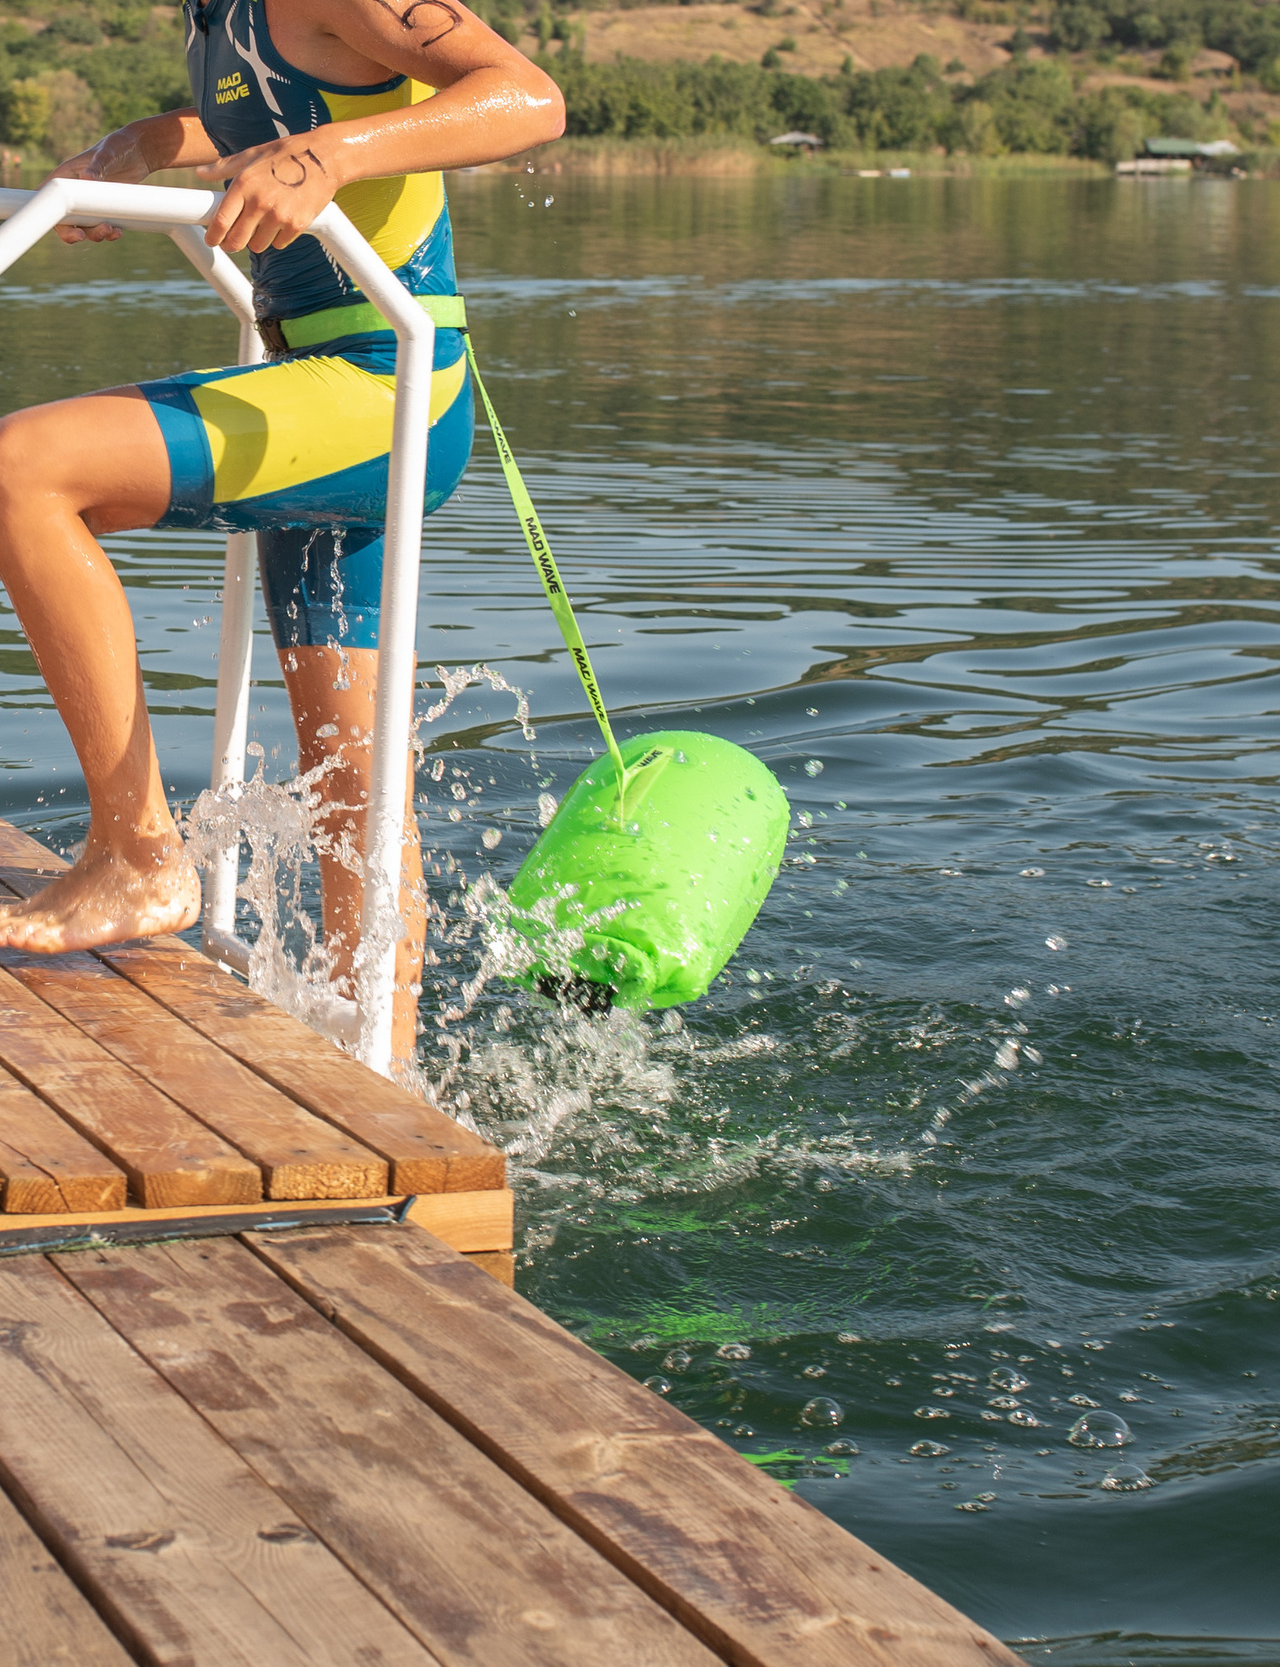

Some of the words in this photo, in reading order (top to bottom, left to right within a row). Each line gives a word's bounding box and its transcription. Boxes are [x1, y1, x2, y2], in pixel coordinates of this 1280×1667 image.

[217, 71, 242, 91] MAD
[215, 83, 250, 105] WAVE
[525, 516, 544, 551] MAD
[538, 552, 561, 594] WAVE
